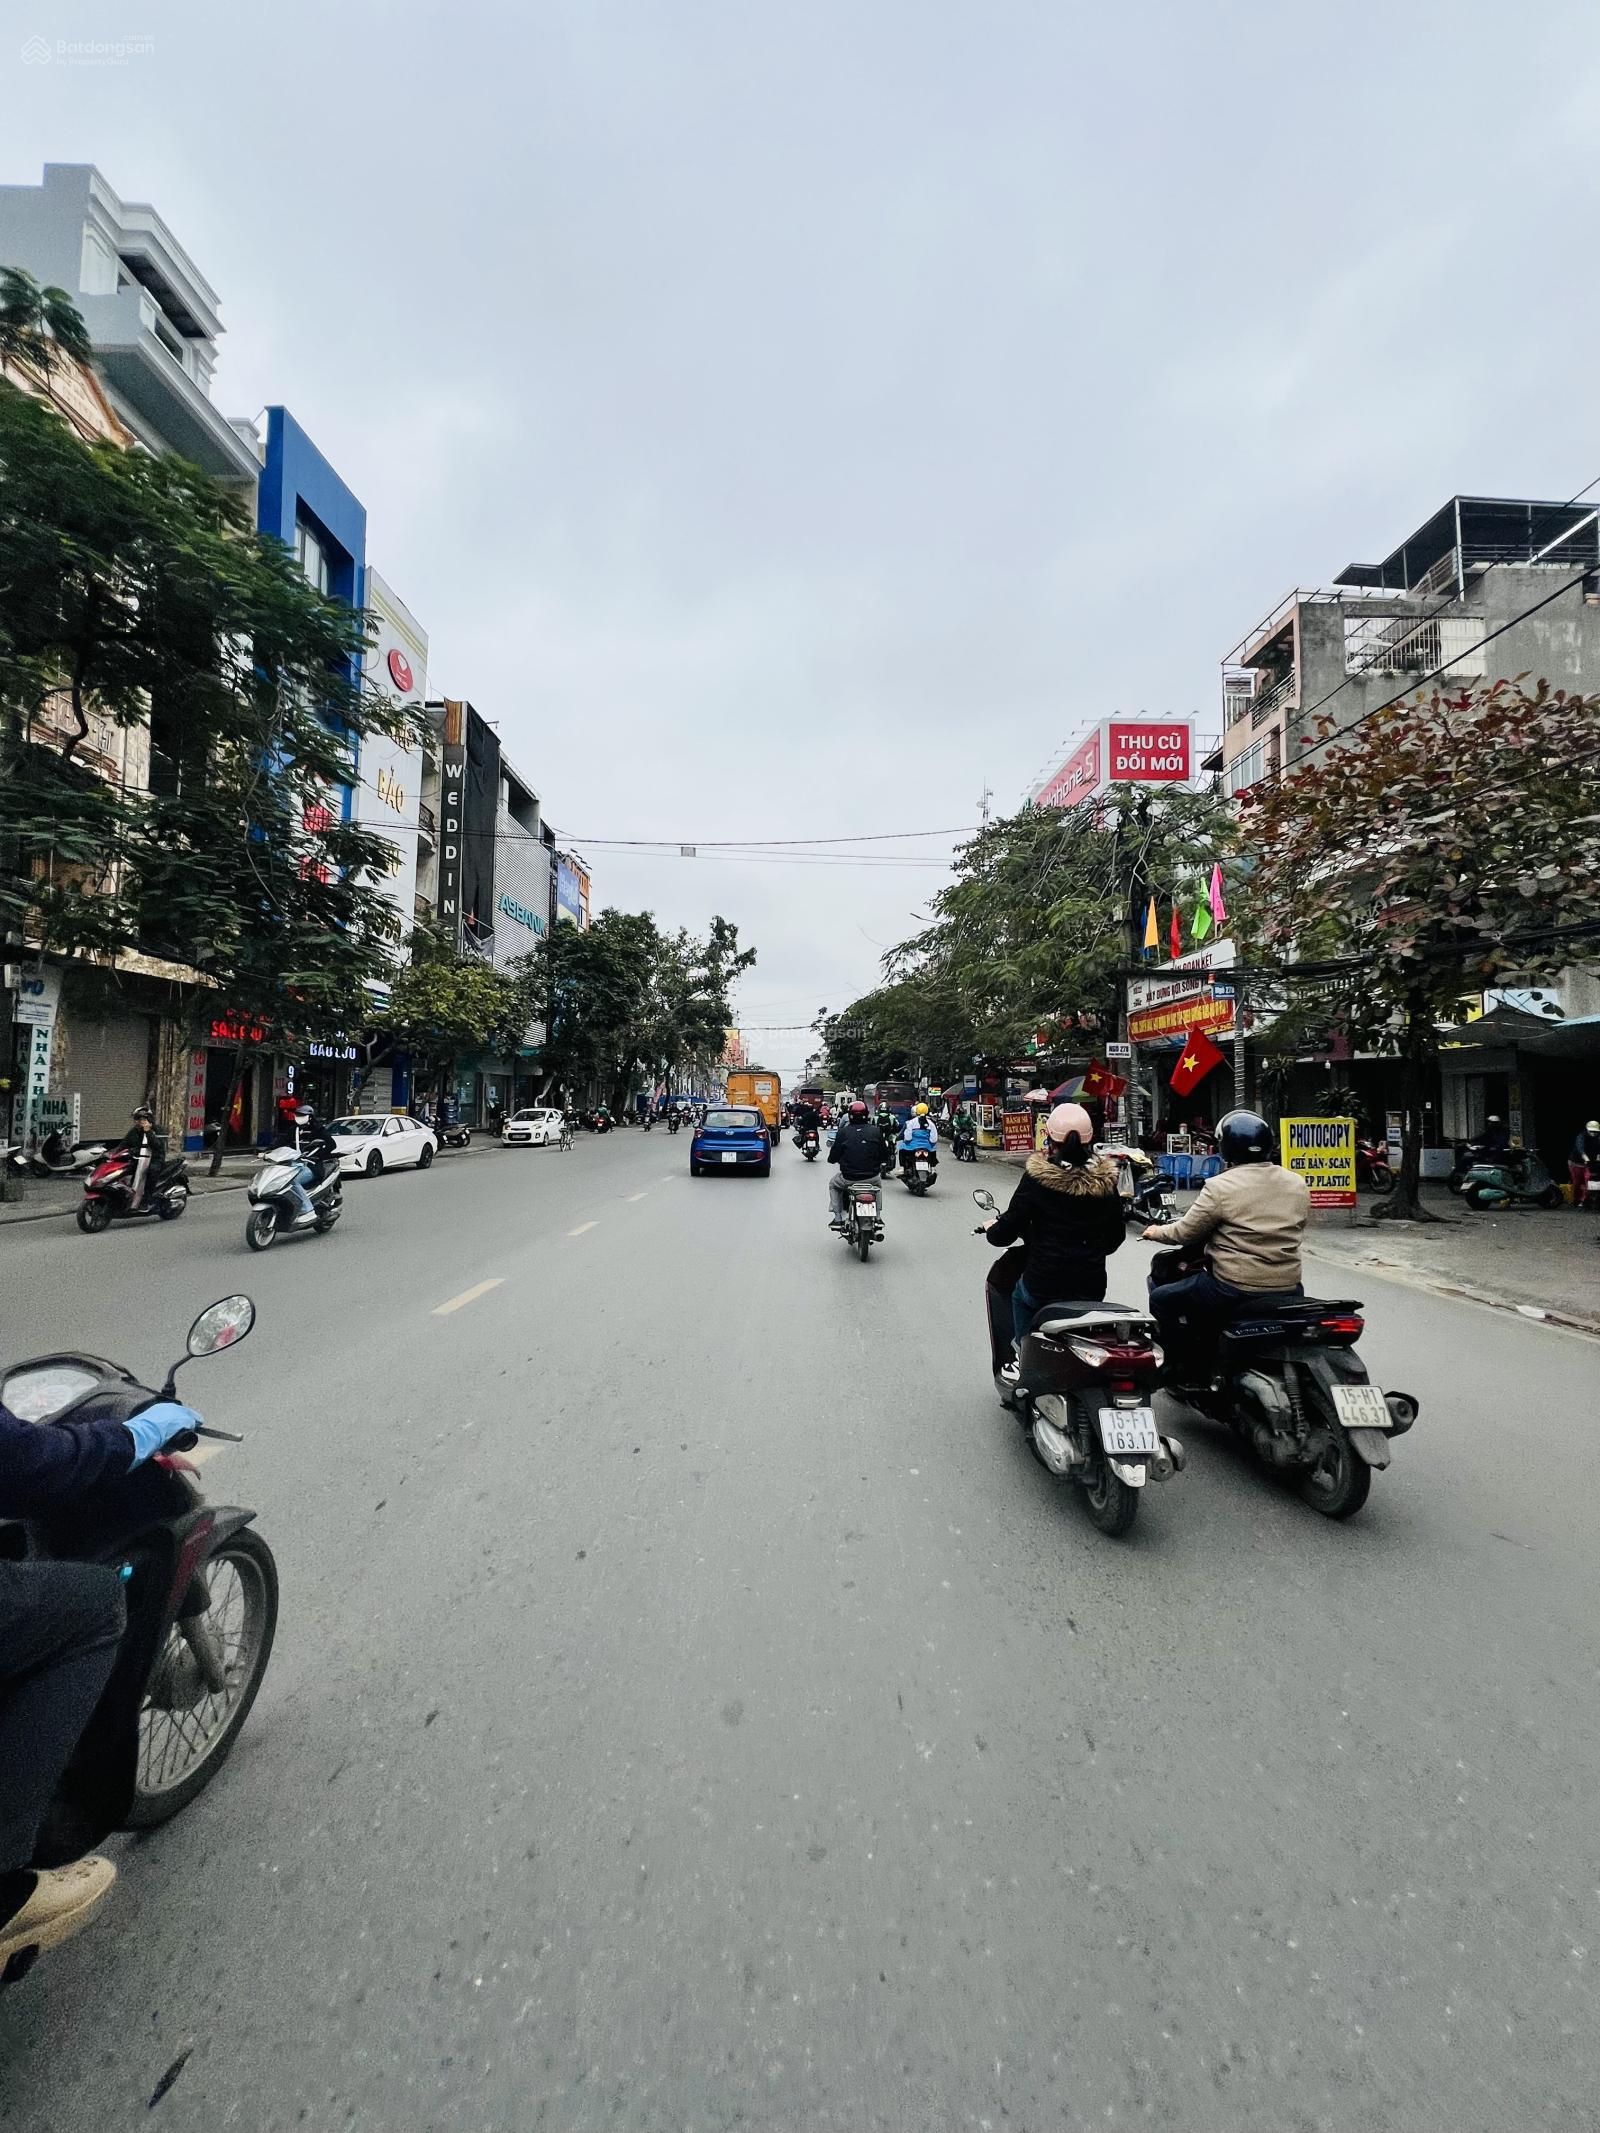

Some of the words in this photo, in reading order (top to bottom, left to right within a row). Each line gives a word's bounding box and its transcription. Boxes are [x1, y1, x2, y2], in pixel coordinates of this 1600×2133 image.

[1117, 735, 1154, 750] THU
[1157, 732, 1181, 750] CŨ
[1116, 751, 1146, 771] ĐỔI
[1150, 753, 1183, 771] MỚI
[377, 765, 404, 814] BẢO
[499, 893, 547, 936] ABBANK
[42, 1097, 68, 1115] NHÀ
[1289, 1123, 1351, 1148] PHOTOCOPY
[1290, 1153, 1306, 1170] CHẾ
[1308, 1154, 1325, 1169] BẢN
[1328, 1157, 1351, 1169] SCAN
[1316, 1175, 1351, 1187] PLASTIC
[1340, 1388, 1378, 1405] 15-H1
[1108, 1411, 1148, 1430] 15-F1
[1341, 1406, 1387, 1423] 446.37
[1107, 1431, 1155, 1450] 163.17
